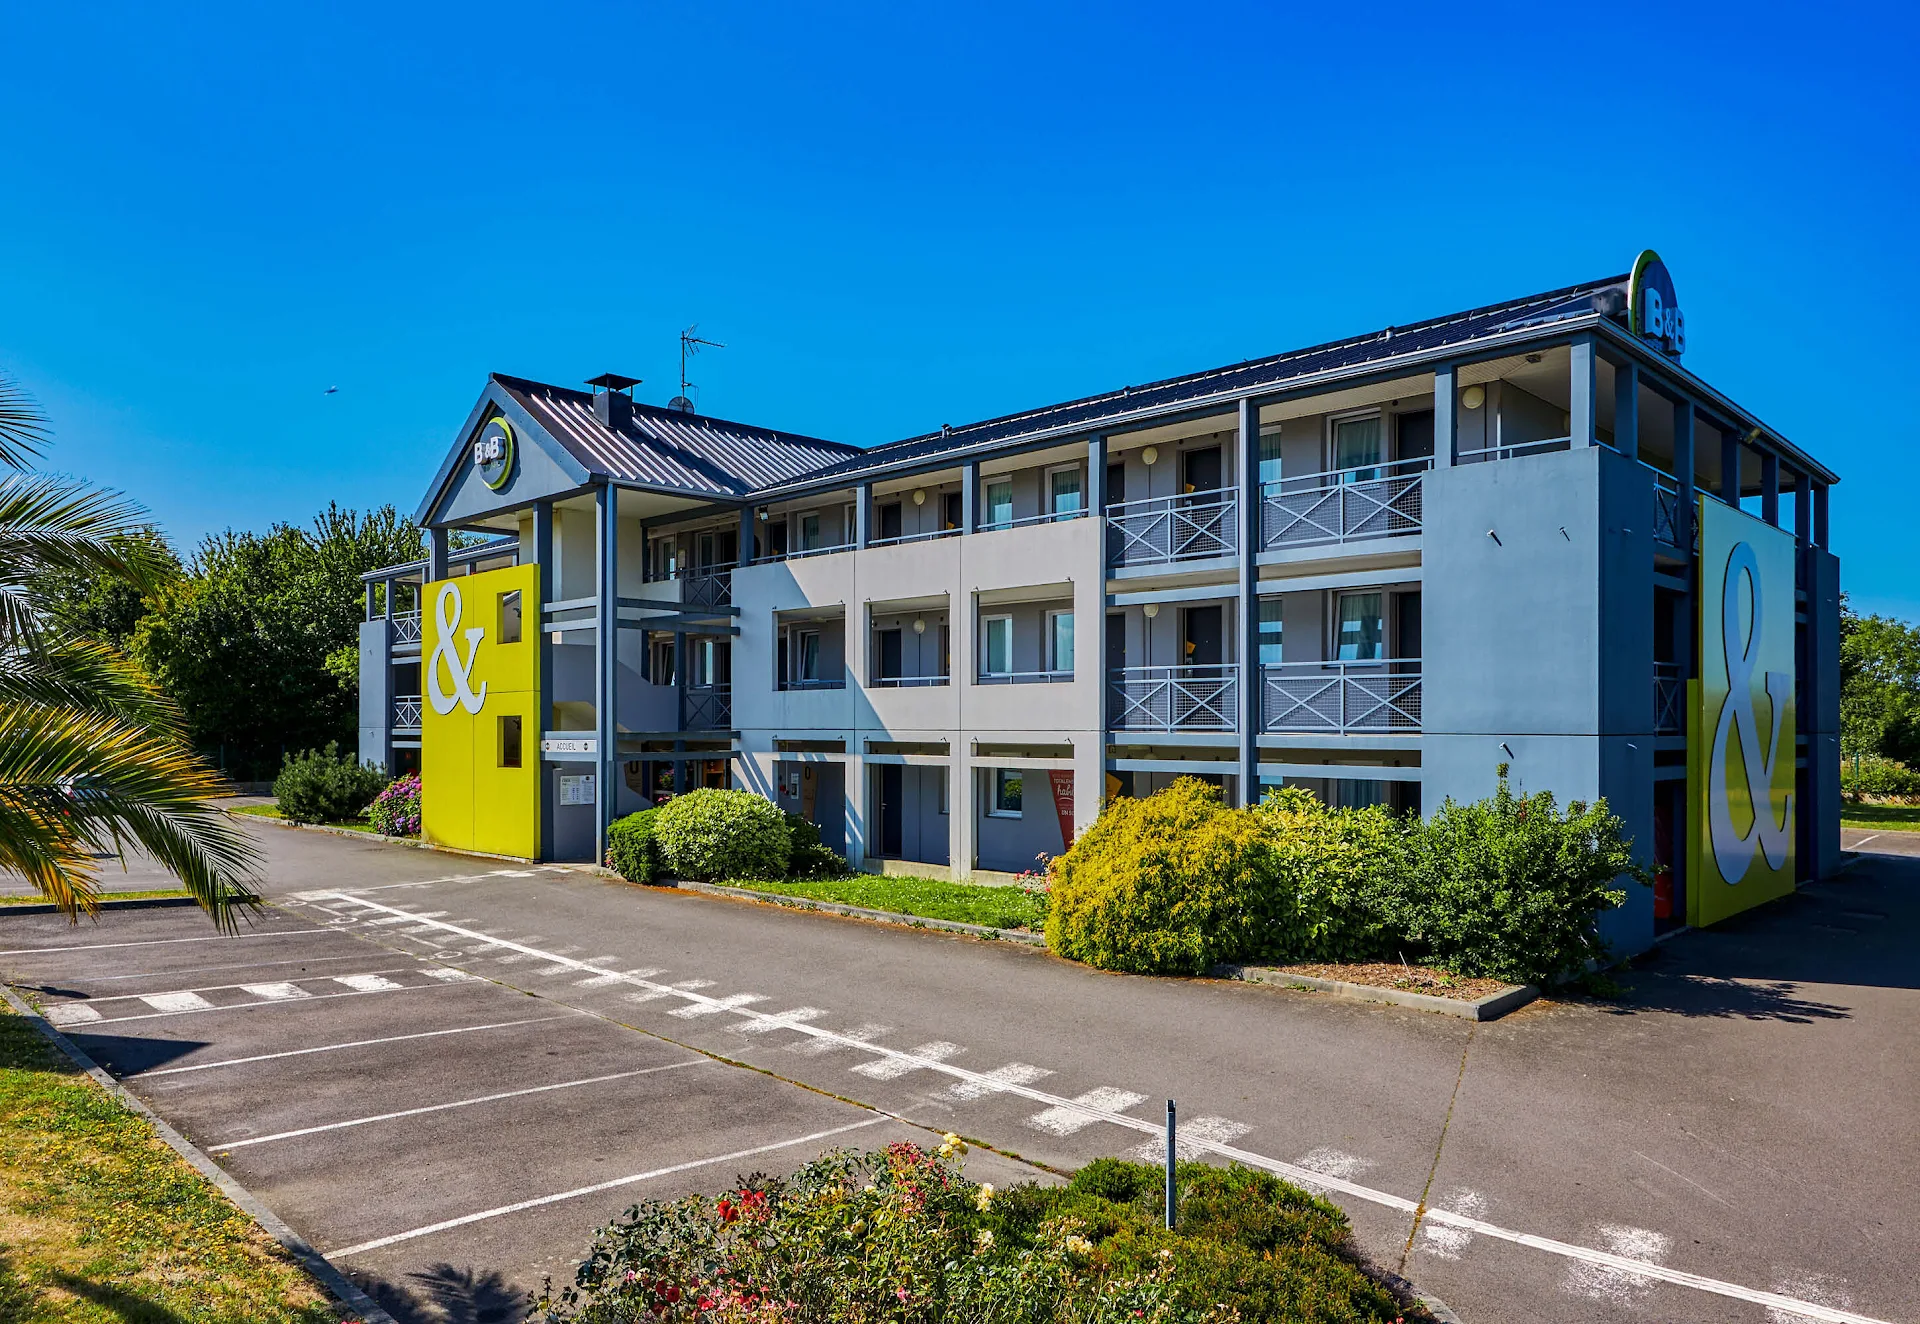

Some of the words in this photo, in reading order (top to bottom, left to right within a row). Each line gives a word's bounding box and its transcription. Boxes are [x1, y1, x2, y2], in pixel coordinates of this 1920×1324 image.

[1645, 287, 1685, 355] B&B
[474, 436, 501, 464] B&B
[556, 742, 576, 751] ACCUEIL
